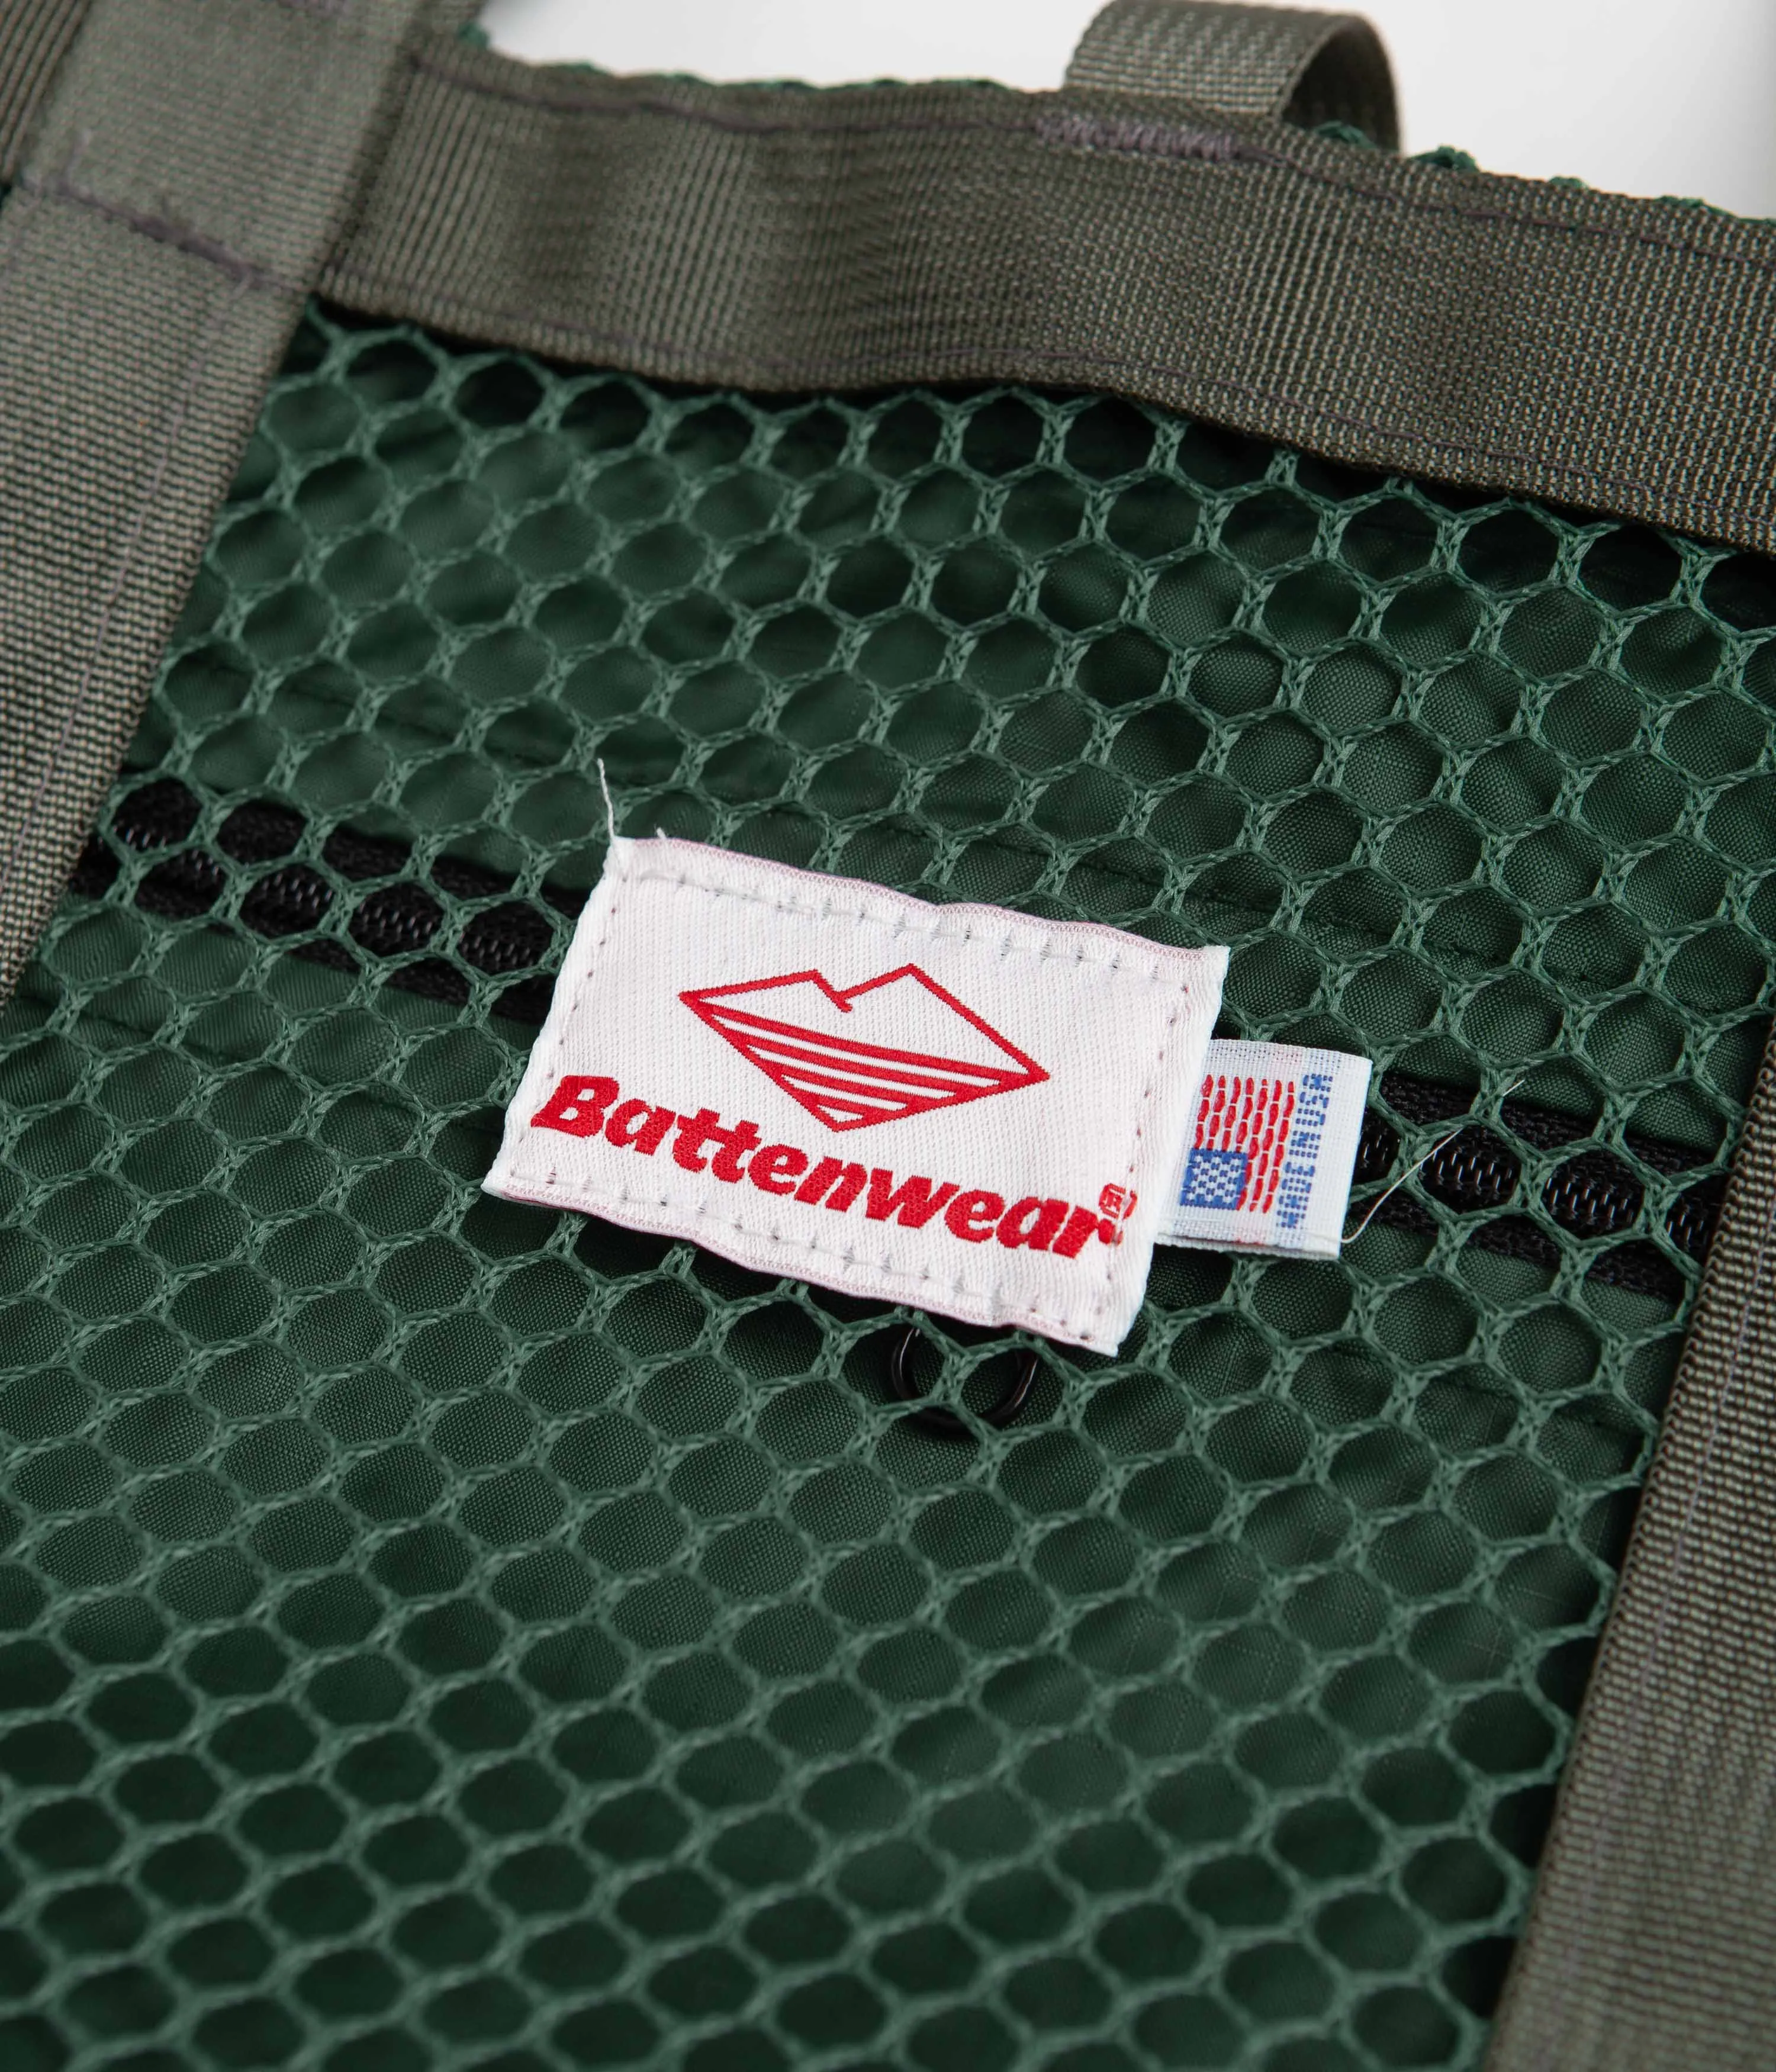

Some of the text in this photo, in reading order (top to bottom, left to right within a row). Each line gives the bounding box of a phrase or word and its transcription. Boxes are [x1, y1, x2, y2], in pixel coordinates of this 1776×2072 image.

[1276, 1073, 1333, 1228] MADE IN USA
